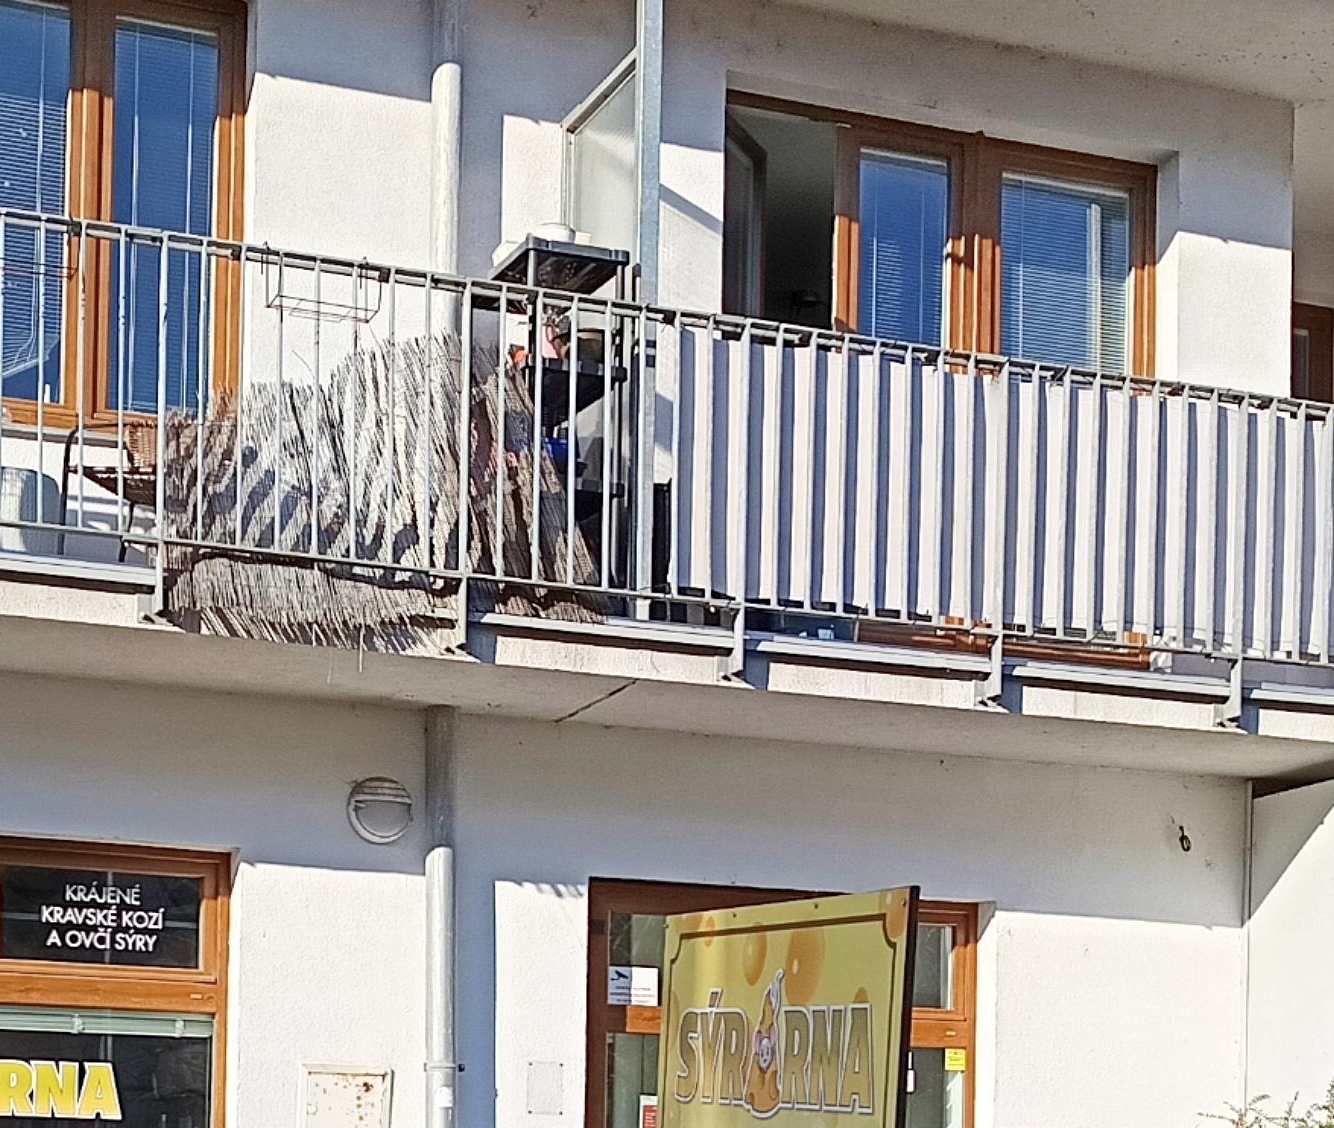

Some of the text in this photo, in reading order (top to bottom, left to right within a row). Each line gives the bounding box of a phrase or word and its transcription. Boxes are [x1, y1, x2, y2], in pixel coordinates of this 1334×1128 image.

[65, 880, 142, 906] KRÁJENÉ
[41, 904, 165, 930] KRAVSKÉ KOZÍ
[46, 927, 158, 952] A OVČÍ SÝRY
